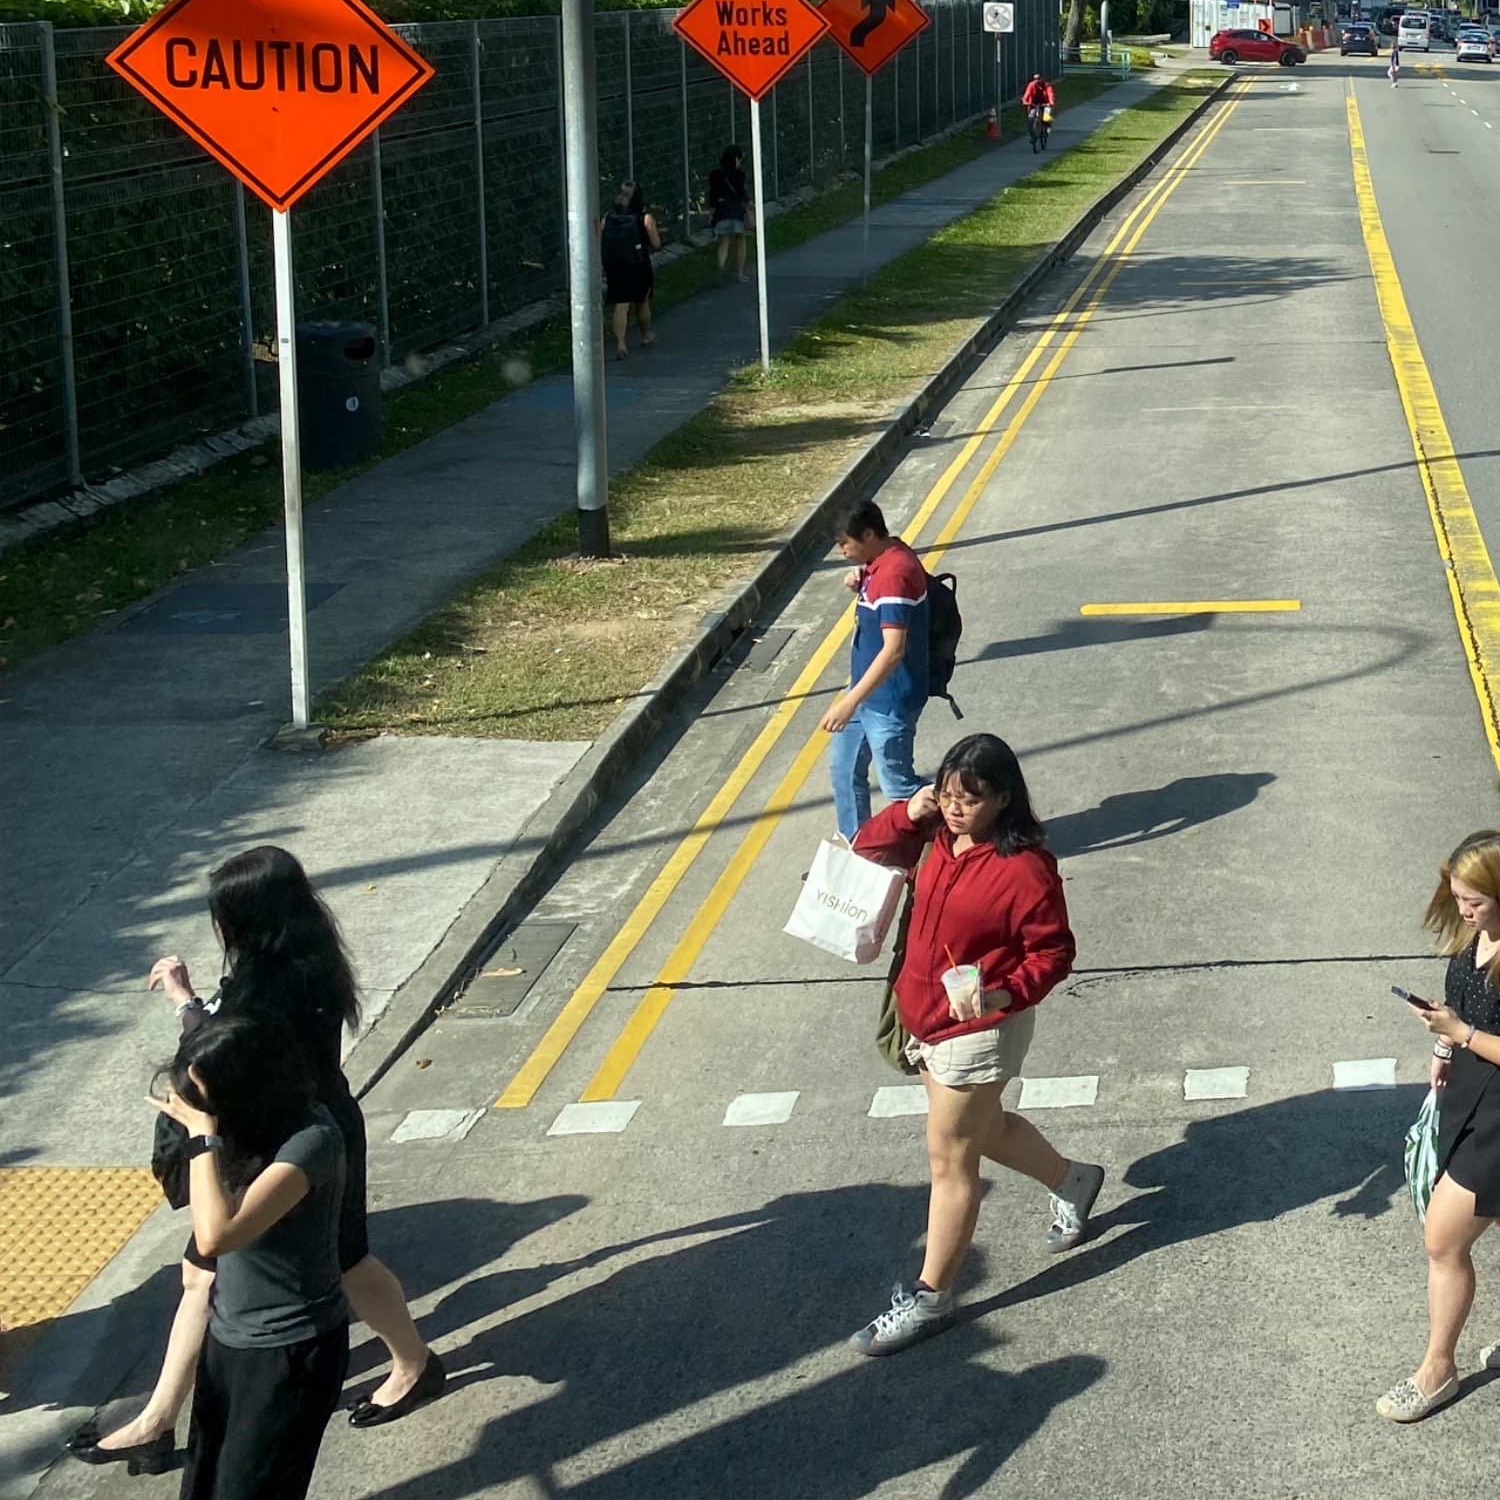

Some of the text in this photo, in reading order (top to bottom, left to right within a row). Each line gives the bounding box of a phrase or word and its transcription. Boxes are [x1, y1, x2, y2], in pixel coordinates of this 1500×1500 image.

[715, 0, 788, 27] Works
[716, 30, 790, 56] Ahead
[164, 36, 380, 95] CAUTION
